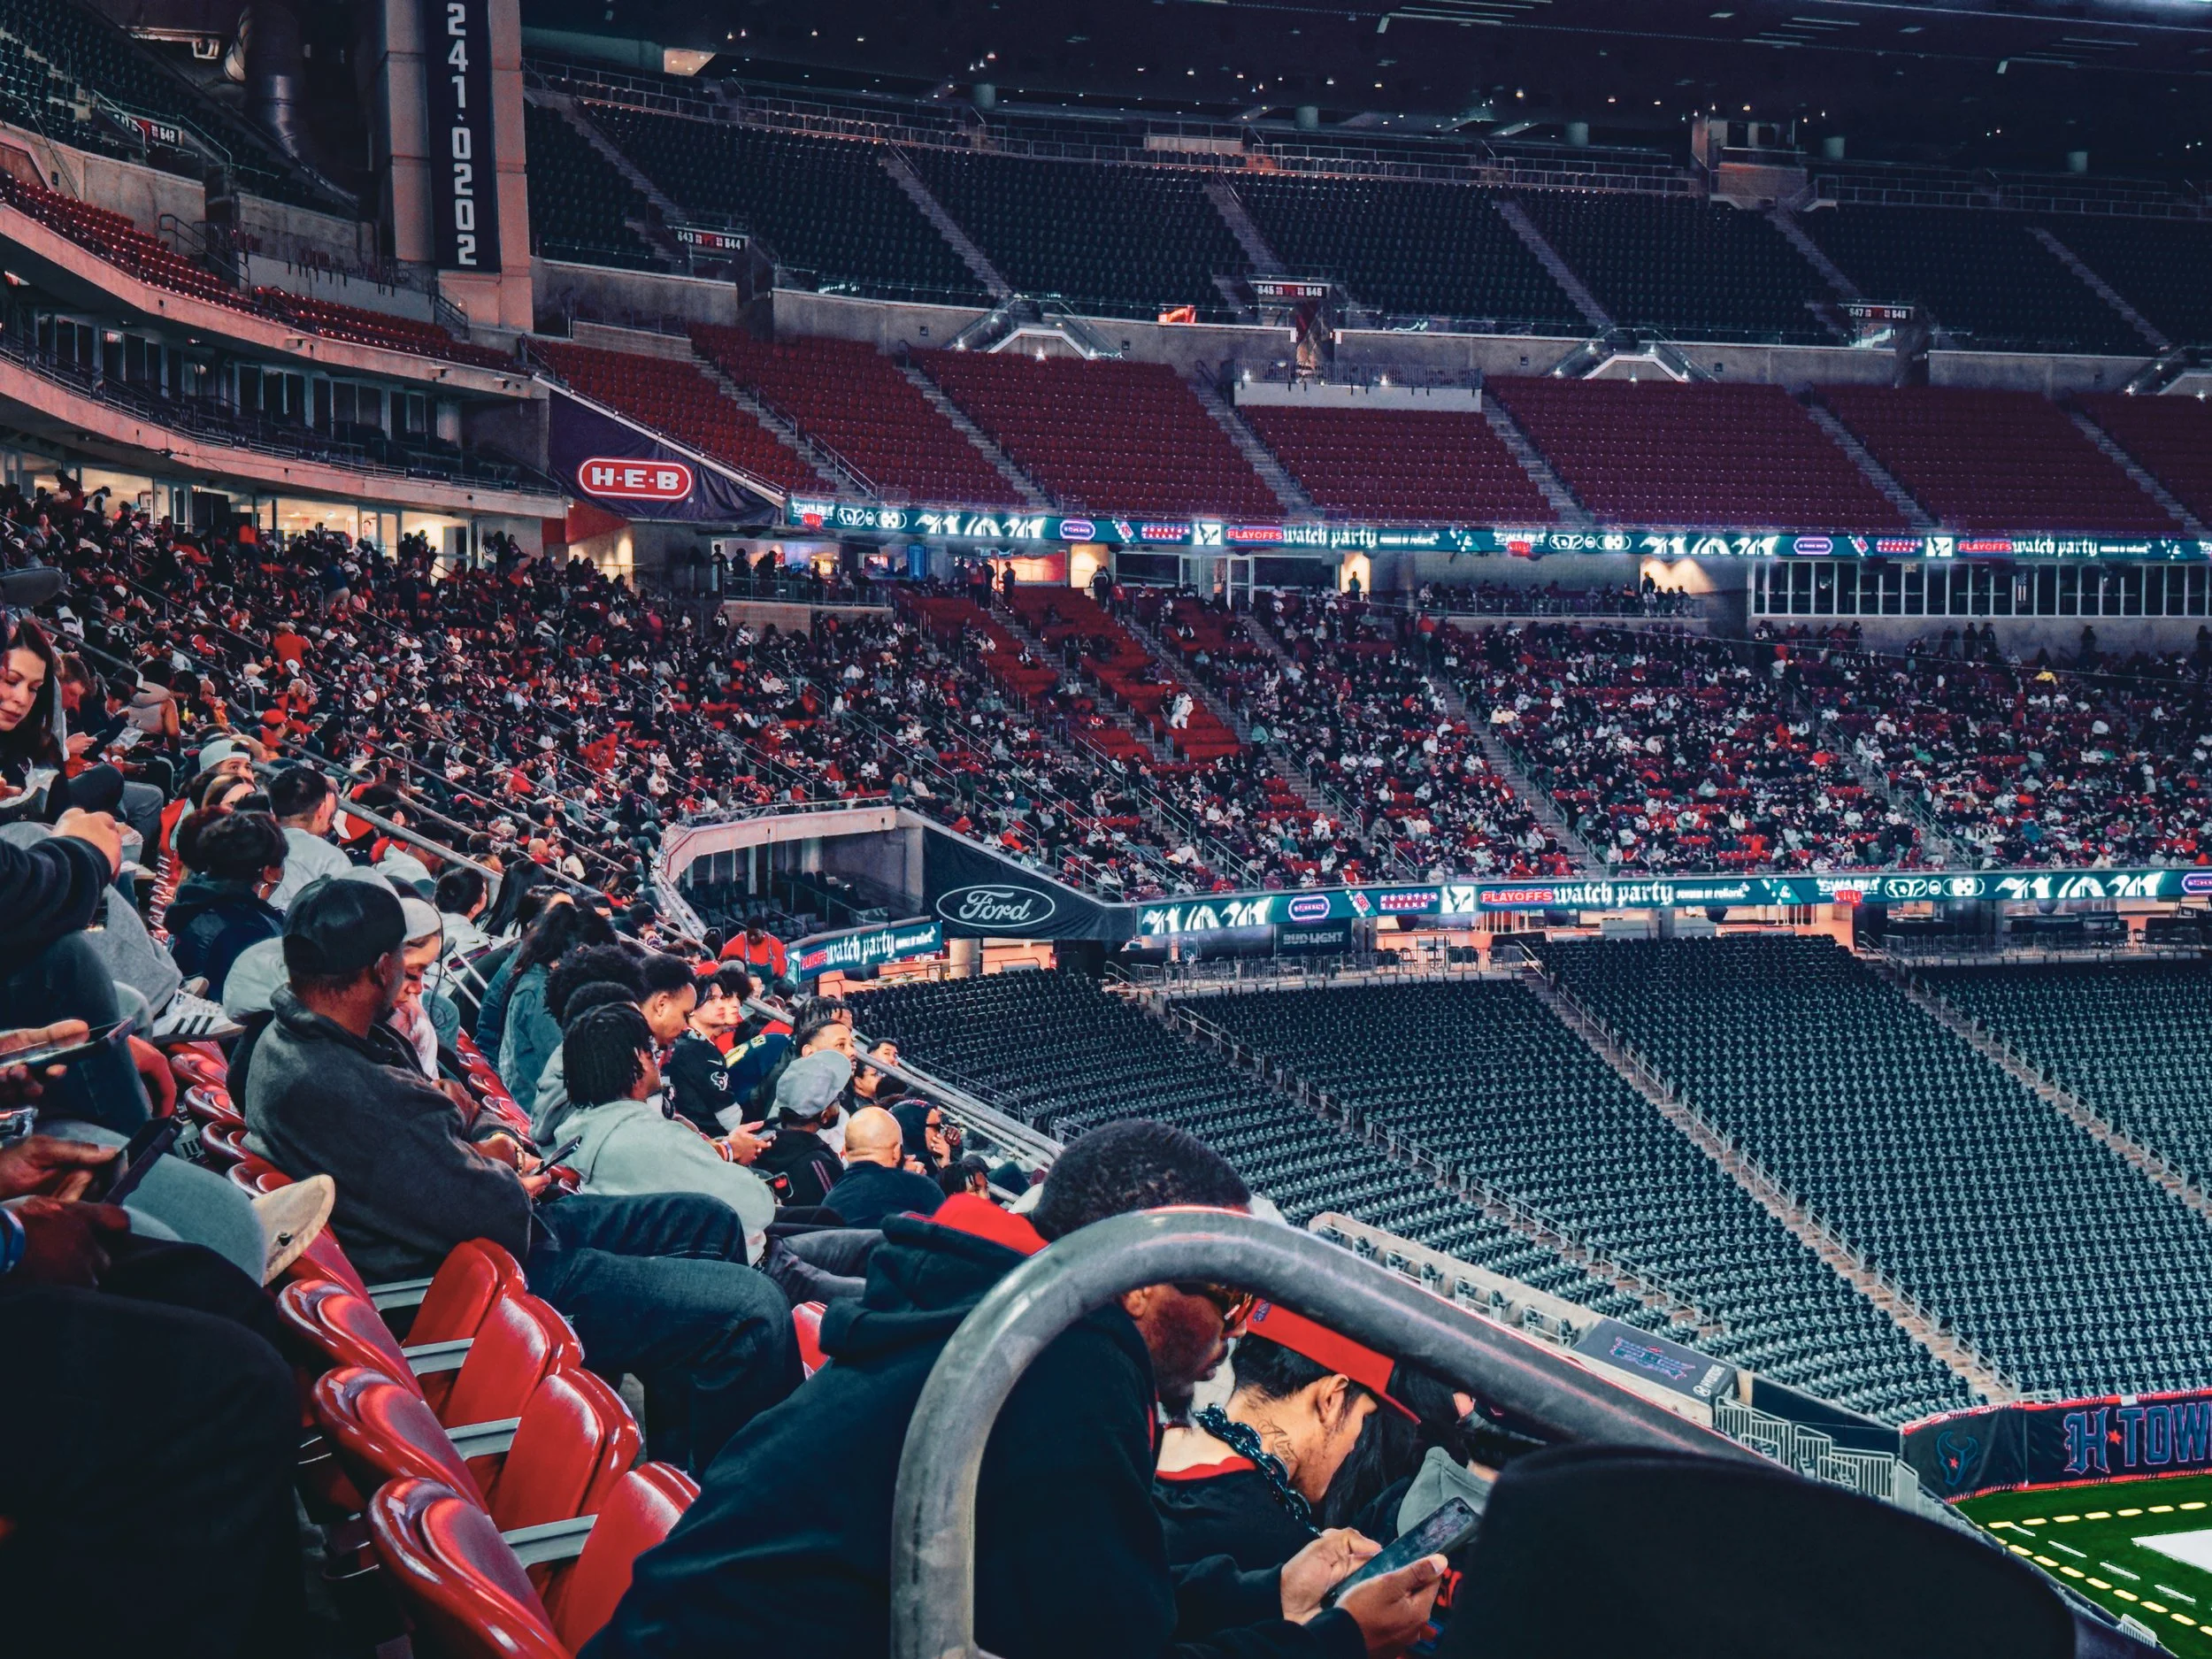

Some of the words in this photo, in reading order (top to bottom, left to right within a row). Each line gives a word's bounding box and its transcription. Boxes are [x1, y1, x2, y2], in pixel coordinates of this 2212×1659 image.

[160, 127, 175, 143] 642
[677, 231, 694, 243] 643
[725, 239, 741, 250] 644
[1226, 527, 1284, 541] PLAYOFFS
[1284, 526, 1328, 546] watch
[1330, 528, 1379, 549] party
[1957, 541, 2013, 553] PLAYOFFS
[2013, 538, 2055, 555] watch
[2057, 538, 2098, 557] party
[1379, 892, 1438, 902] HOUSTON
[1480, 890, 1554, 903] PLAYOFFS
[1554, 879, 1613, 905] watch
[1616, 879, 1674, 907] party
[959, 890, 1034, 922] Ford
[826, 934, 860, 965] watch
[862, 930, 895, 965] party
[1283, 933, 1309, 946] BUD
[1309, 930, 1344, 945] LIGHT
[2116, 1401, 2212, 1467] TOW
